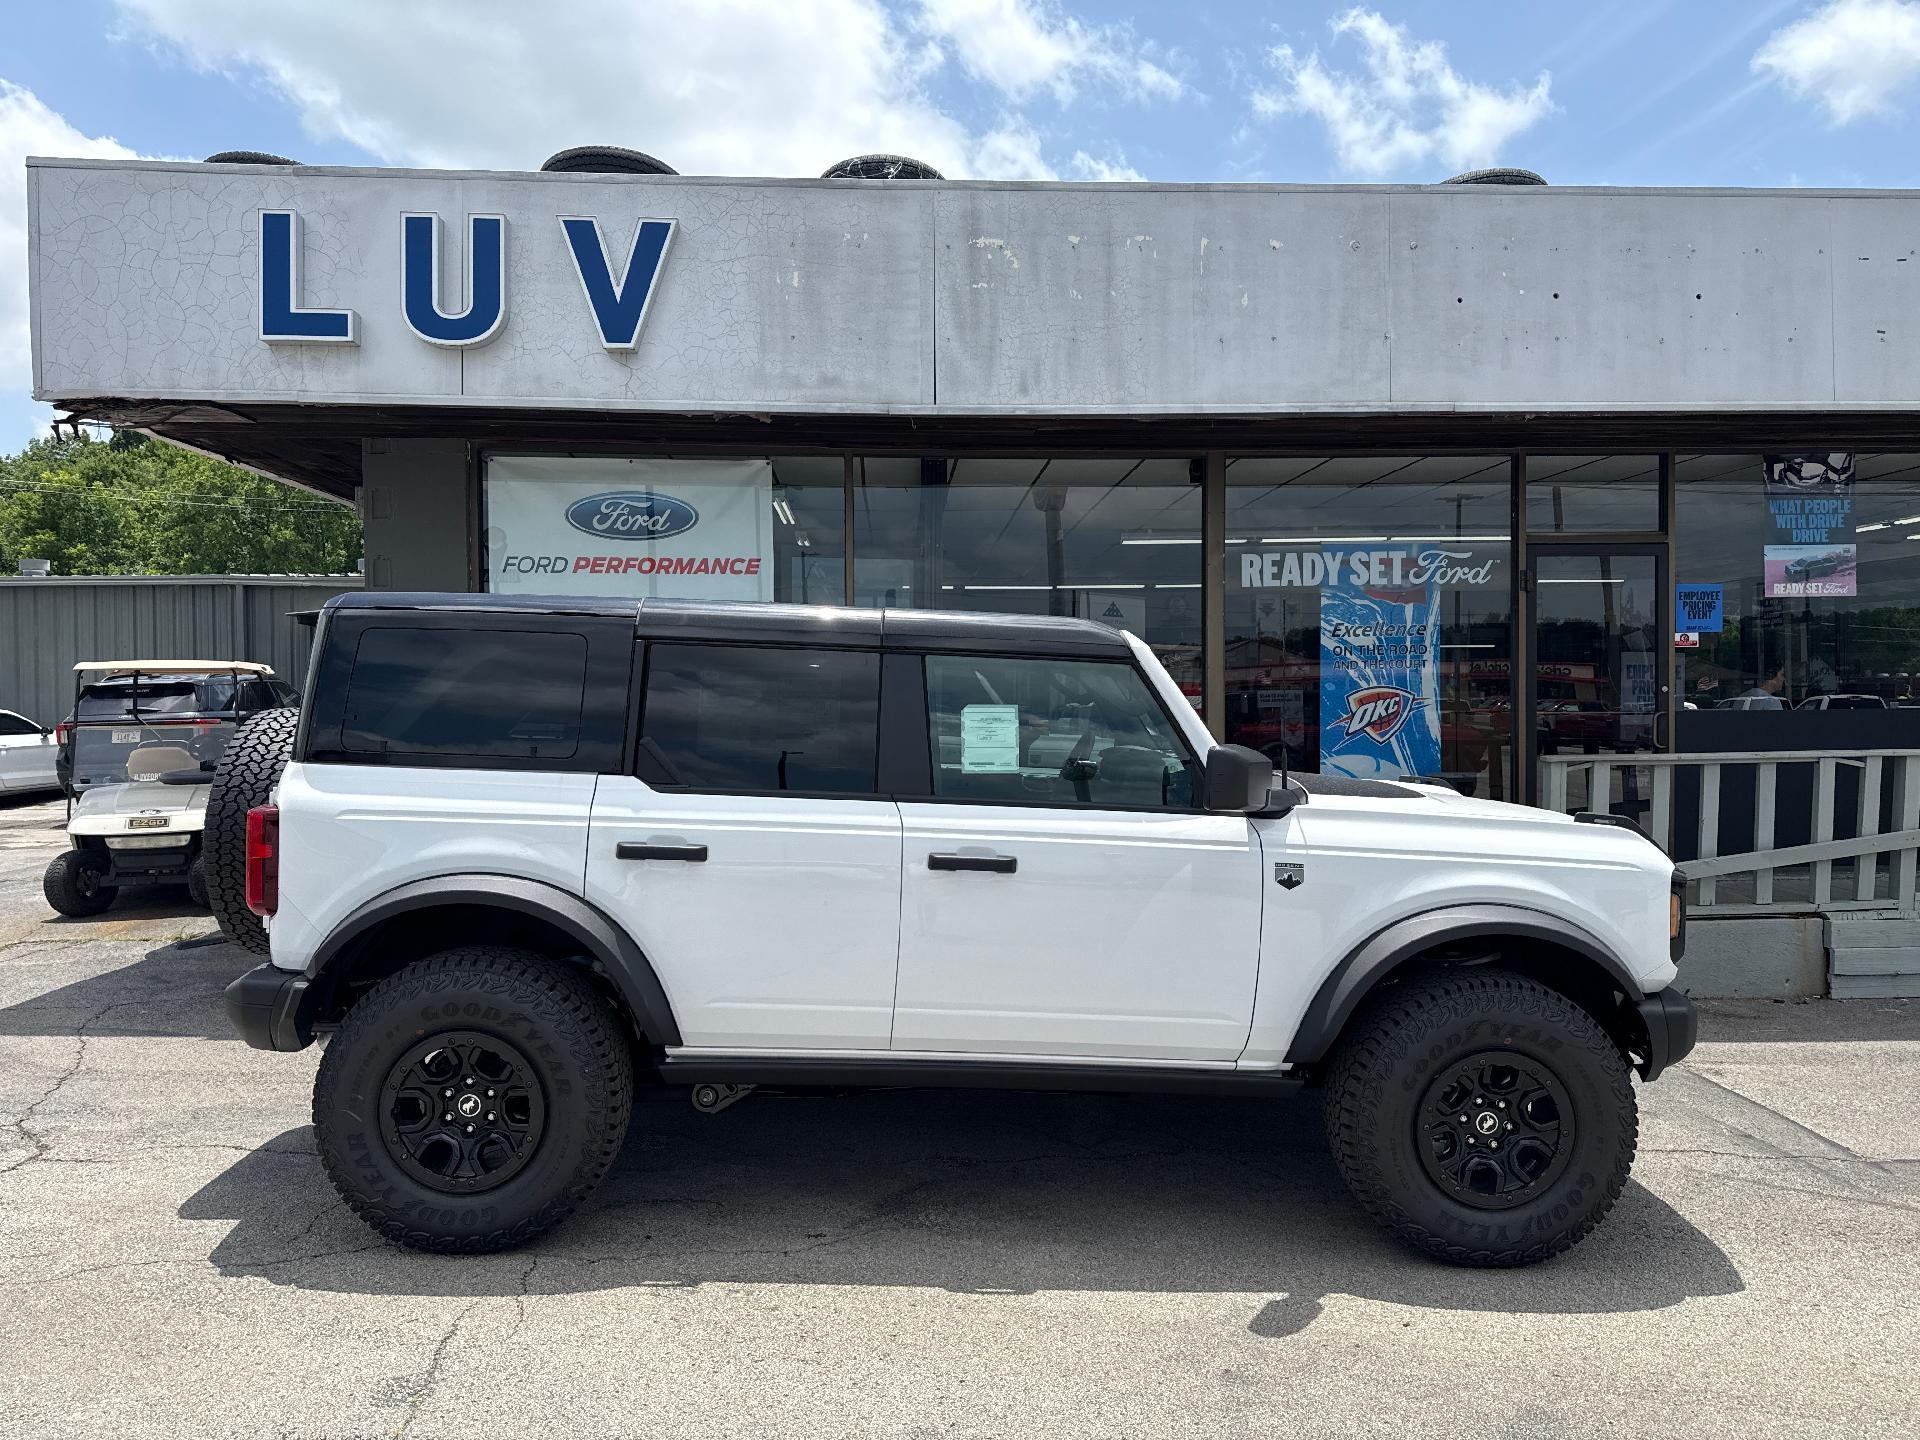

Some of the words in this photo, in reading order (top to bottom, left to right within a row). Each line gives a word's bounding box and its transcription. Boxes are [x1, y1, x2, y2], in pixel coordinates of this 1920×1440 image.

[1769, 499, 1802, 514] WHAT
[1804, 499, 1851, 514] PEOPLE
[592, 499, 672, 531] Ford
[1776, 514, 1807, 529] WITH
[1808, 514, 1845, 528] DRIVE
[1792, 528, 1829, 543] DRIVE
[502, 556, 569, 574] FORD
[572, 556, 762, 575] PERFORMANCE
[1241, 551, 1344, 588] READY
[1350, 551, 1407, 586] SET
[1409, 550, 1494, 585] Ford
[1678, 591, 1721, 601] EMPLOYEE
[1773, 583, 1805, 595] READY
[1806, 583, 1823, 594] SET
[1823, 583, 1849, 594] Ford
[1682, 600, 1716, 611] PRICING
[1687, 610, 1713, 620] EVENT
[1331, 621, 1427, 638] Excellence
[1332, 645, 1353, 657] ON
[1359, 645, 1385, 656] THE
[1389, 644, 1428, 656] ROAD
[1333, 660, 1359, 671] AND
[1361, 660, 1385, 670] THE
[1388, 659, 1428, 669] COURT
[1348, 696, 1400, 735] OKC
